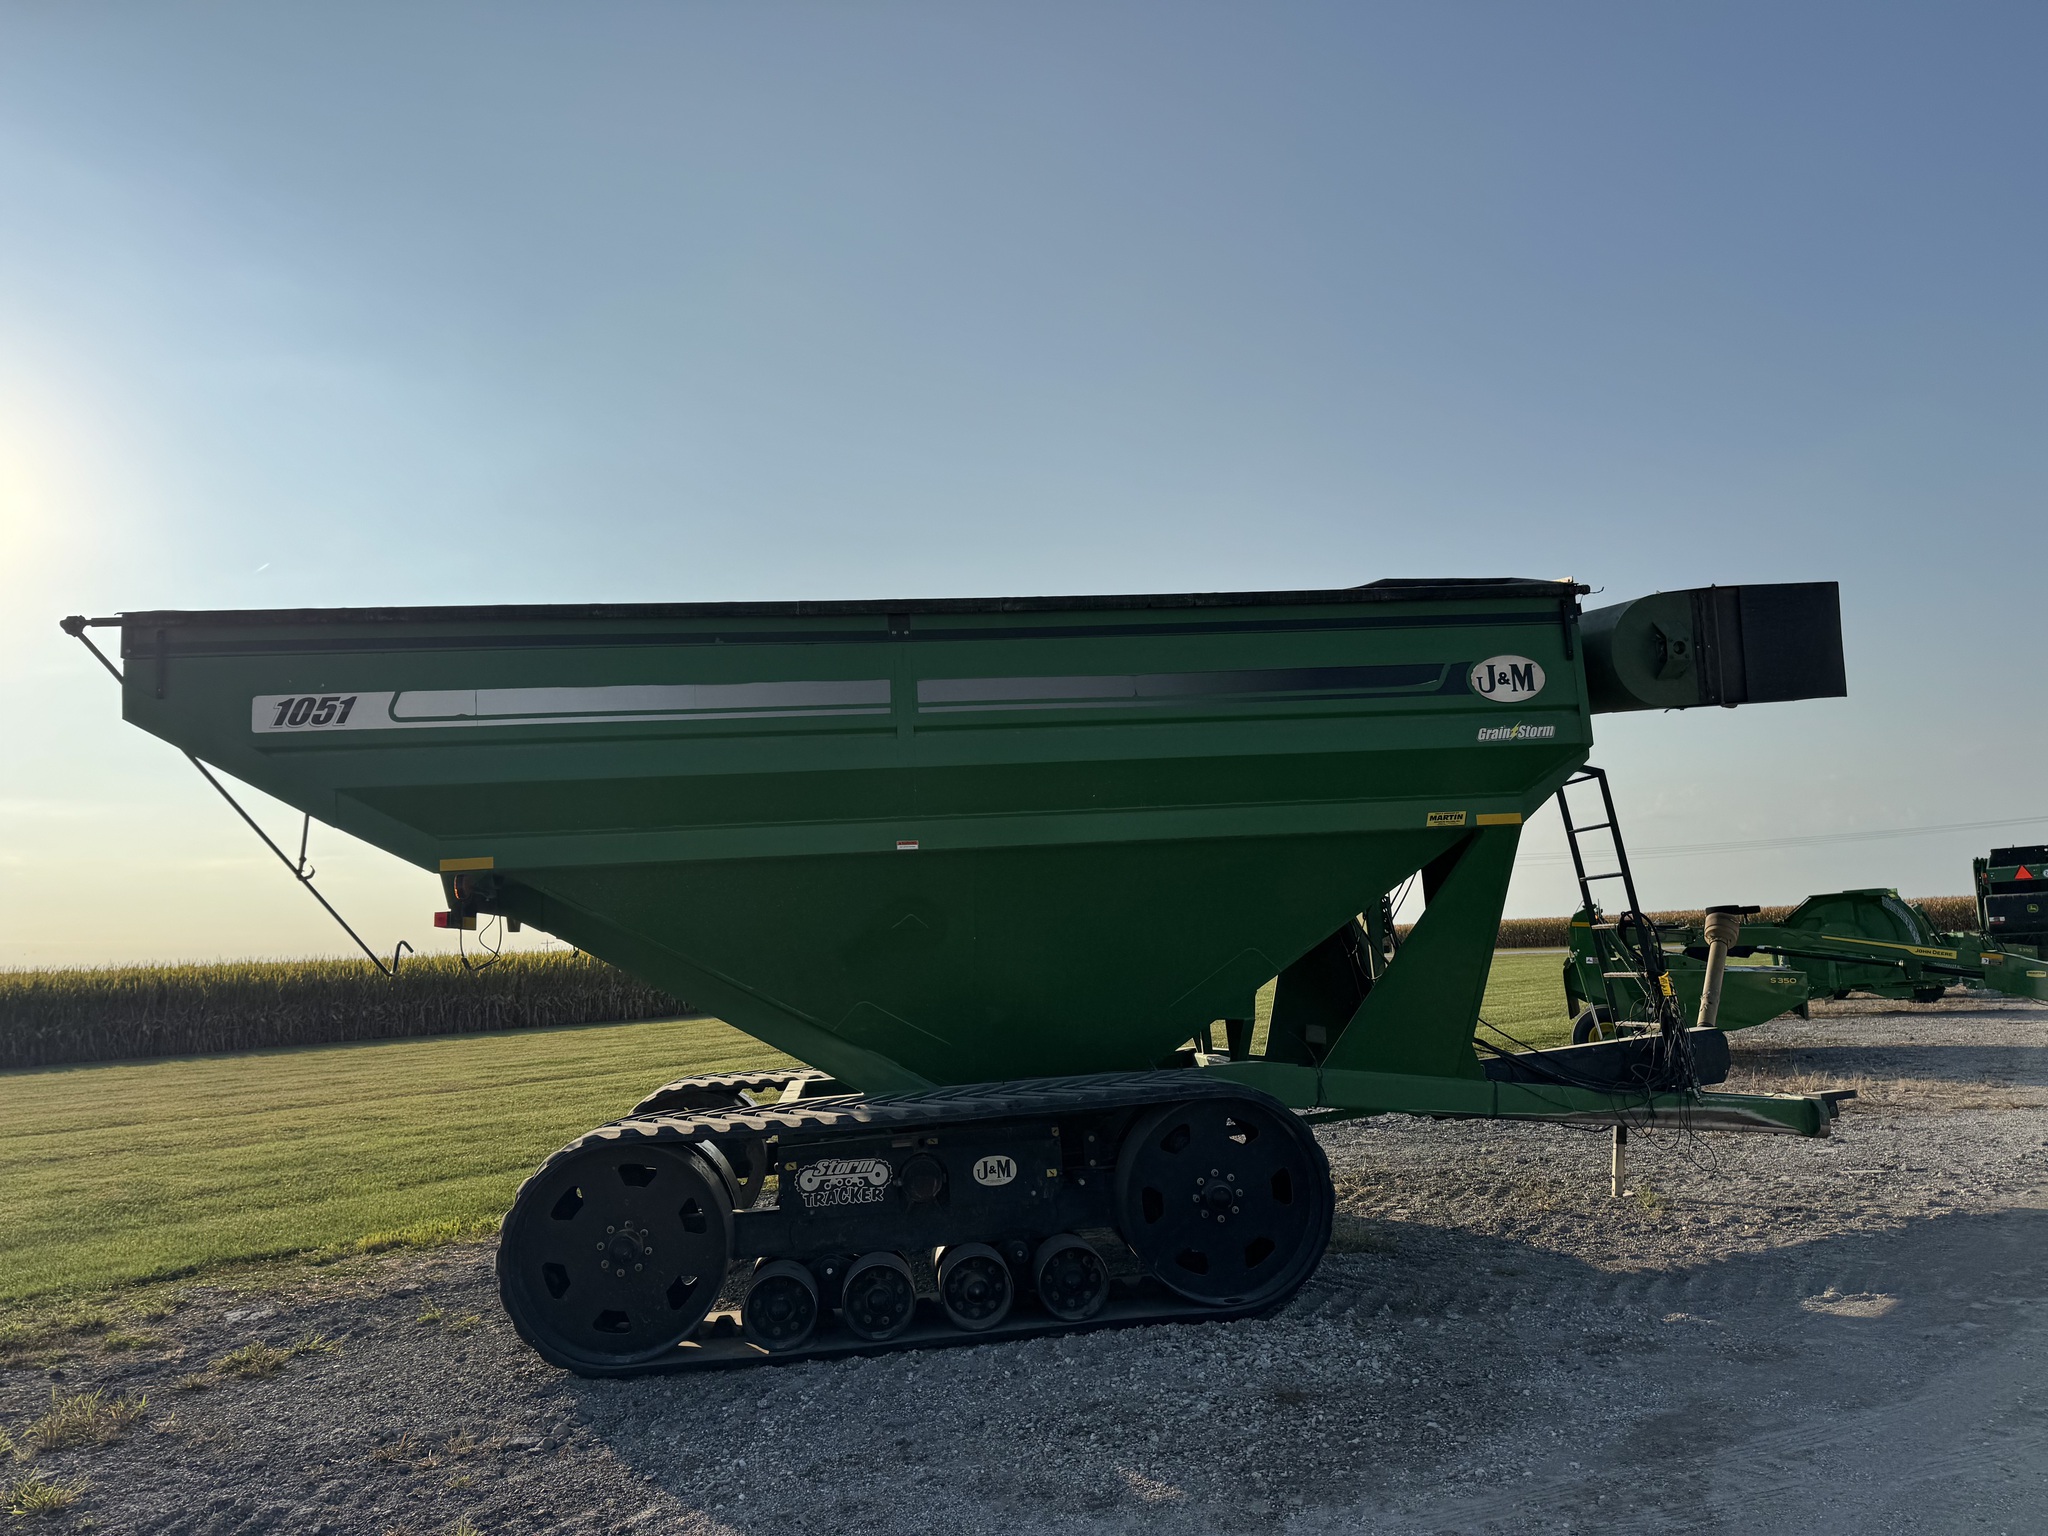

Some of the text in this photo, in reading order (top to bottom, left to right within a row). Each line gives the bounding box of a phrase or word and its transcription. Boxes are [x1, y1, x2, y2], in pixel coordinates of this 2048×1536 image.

[1476, 663, 1536, 693] J&M
[269, 696, 357, 728] 1051
[1478, 724, 1555, 741] Grain Storm
[1429, 813, 1464, 822] MARTIN
[814, 1158, 877, 1177] Storm
[977, 1159, 1012, 1179] J&M
[802, 1185, 885, 1208] TRACKER
